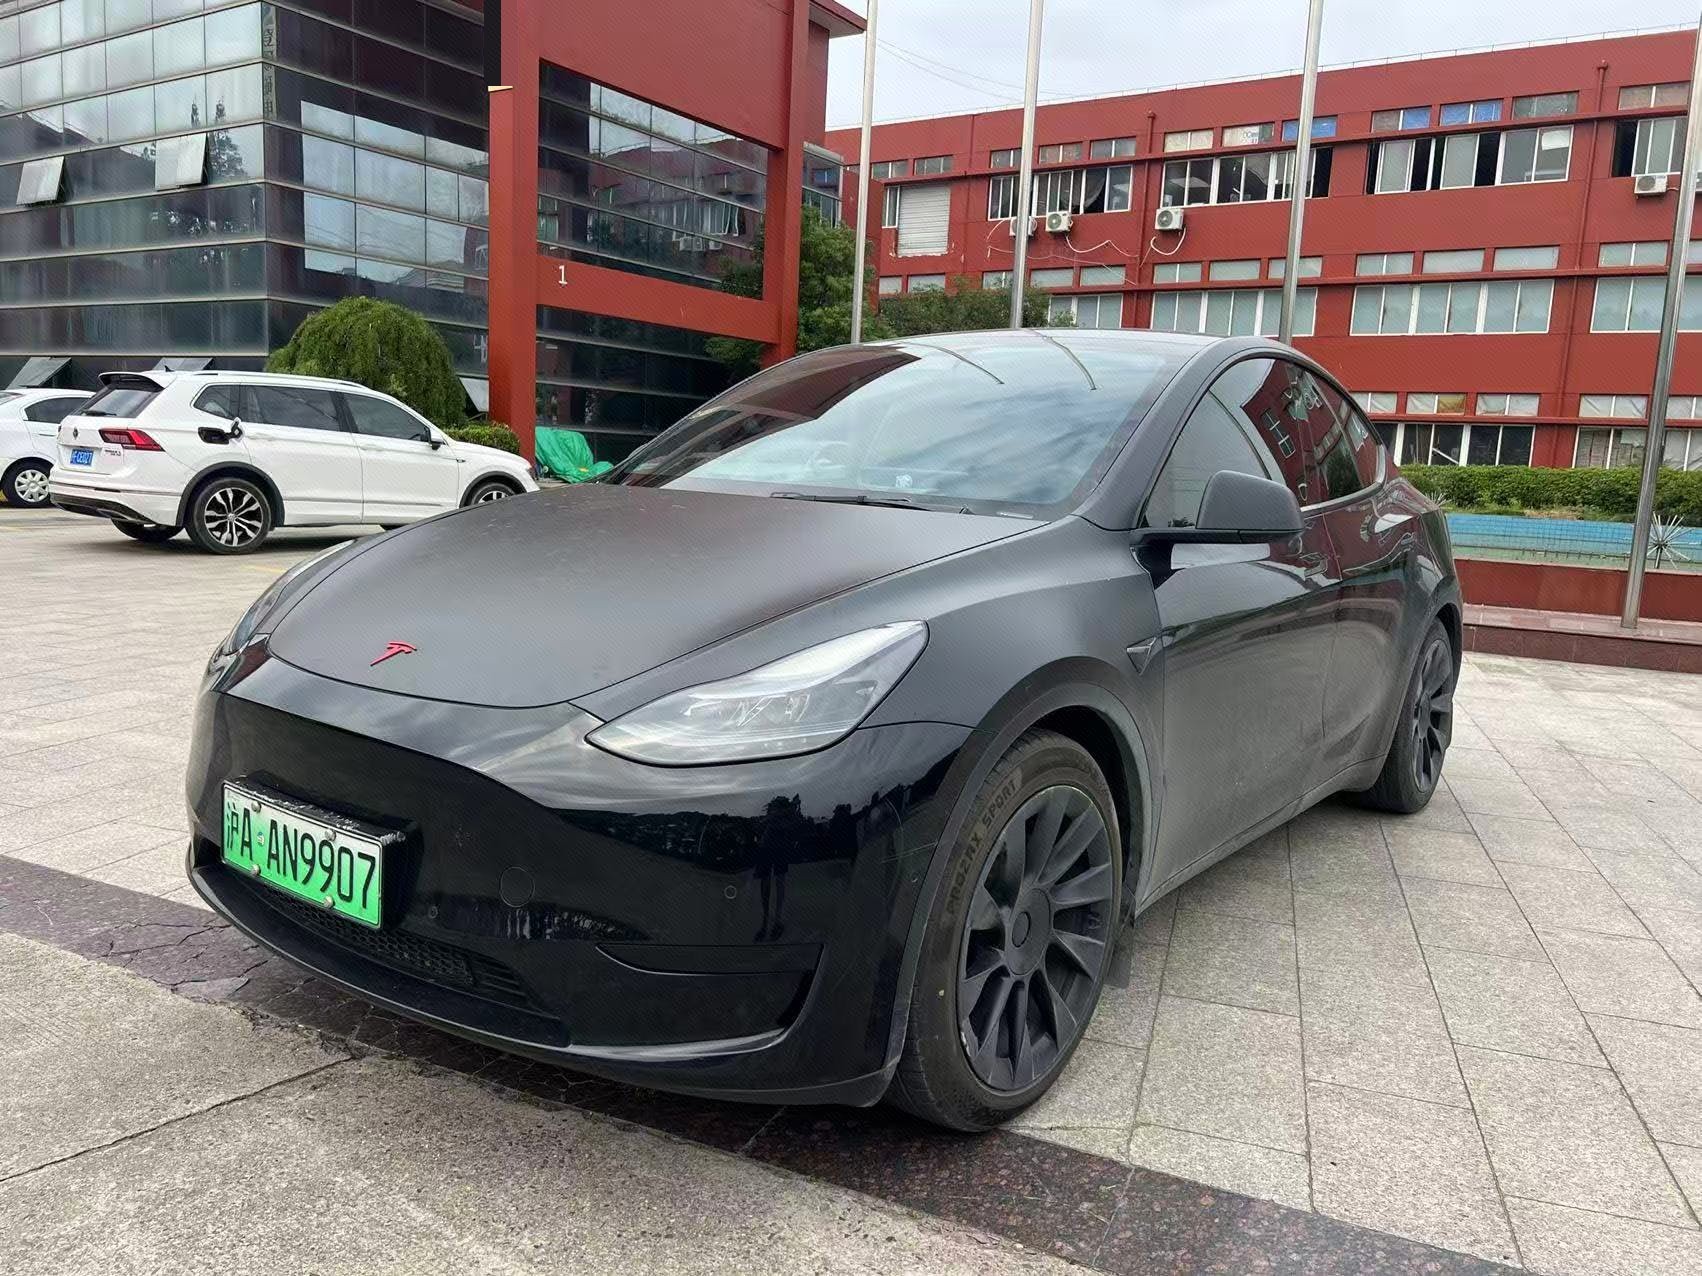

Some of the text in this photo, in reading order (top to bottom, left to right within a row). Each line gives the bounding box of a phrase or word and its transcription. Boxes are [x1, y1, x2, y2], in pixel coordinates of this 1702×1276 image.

[558, 264, 568, 285] 1
[981, 779, 1018, 828] SPORT
[266, 819, 376, 910] AN9907
